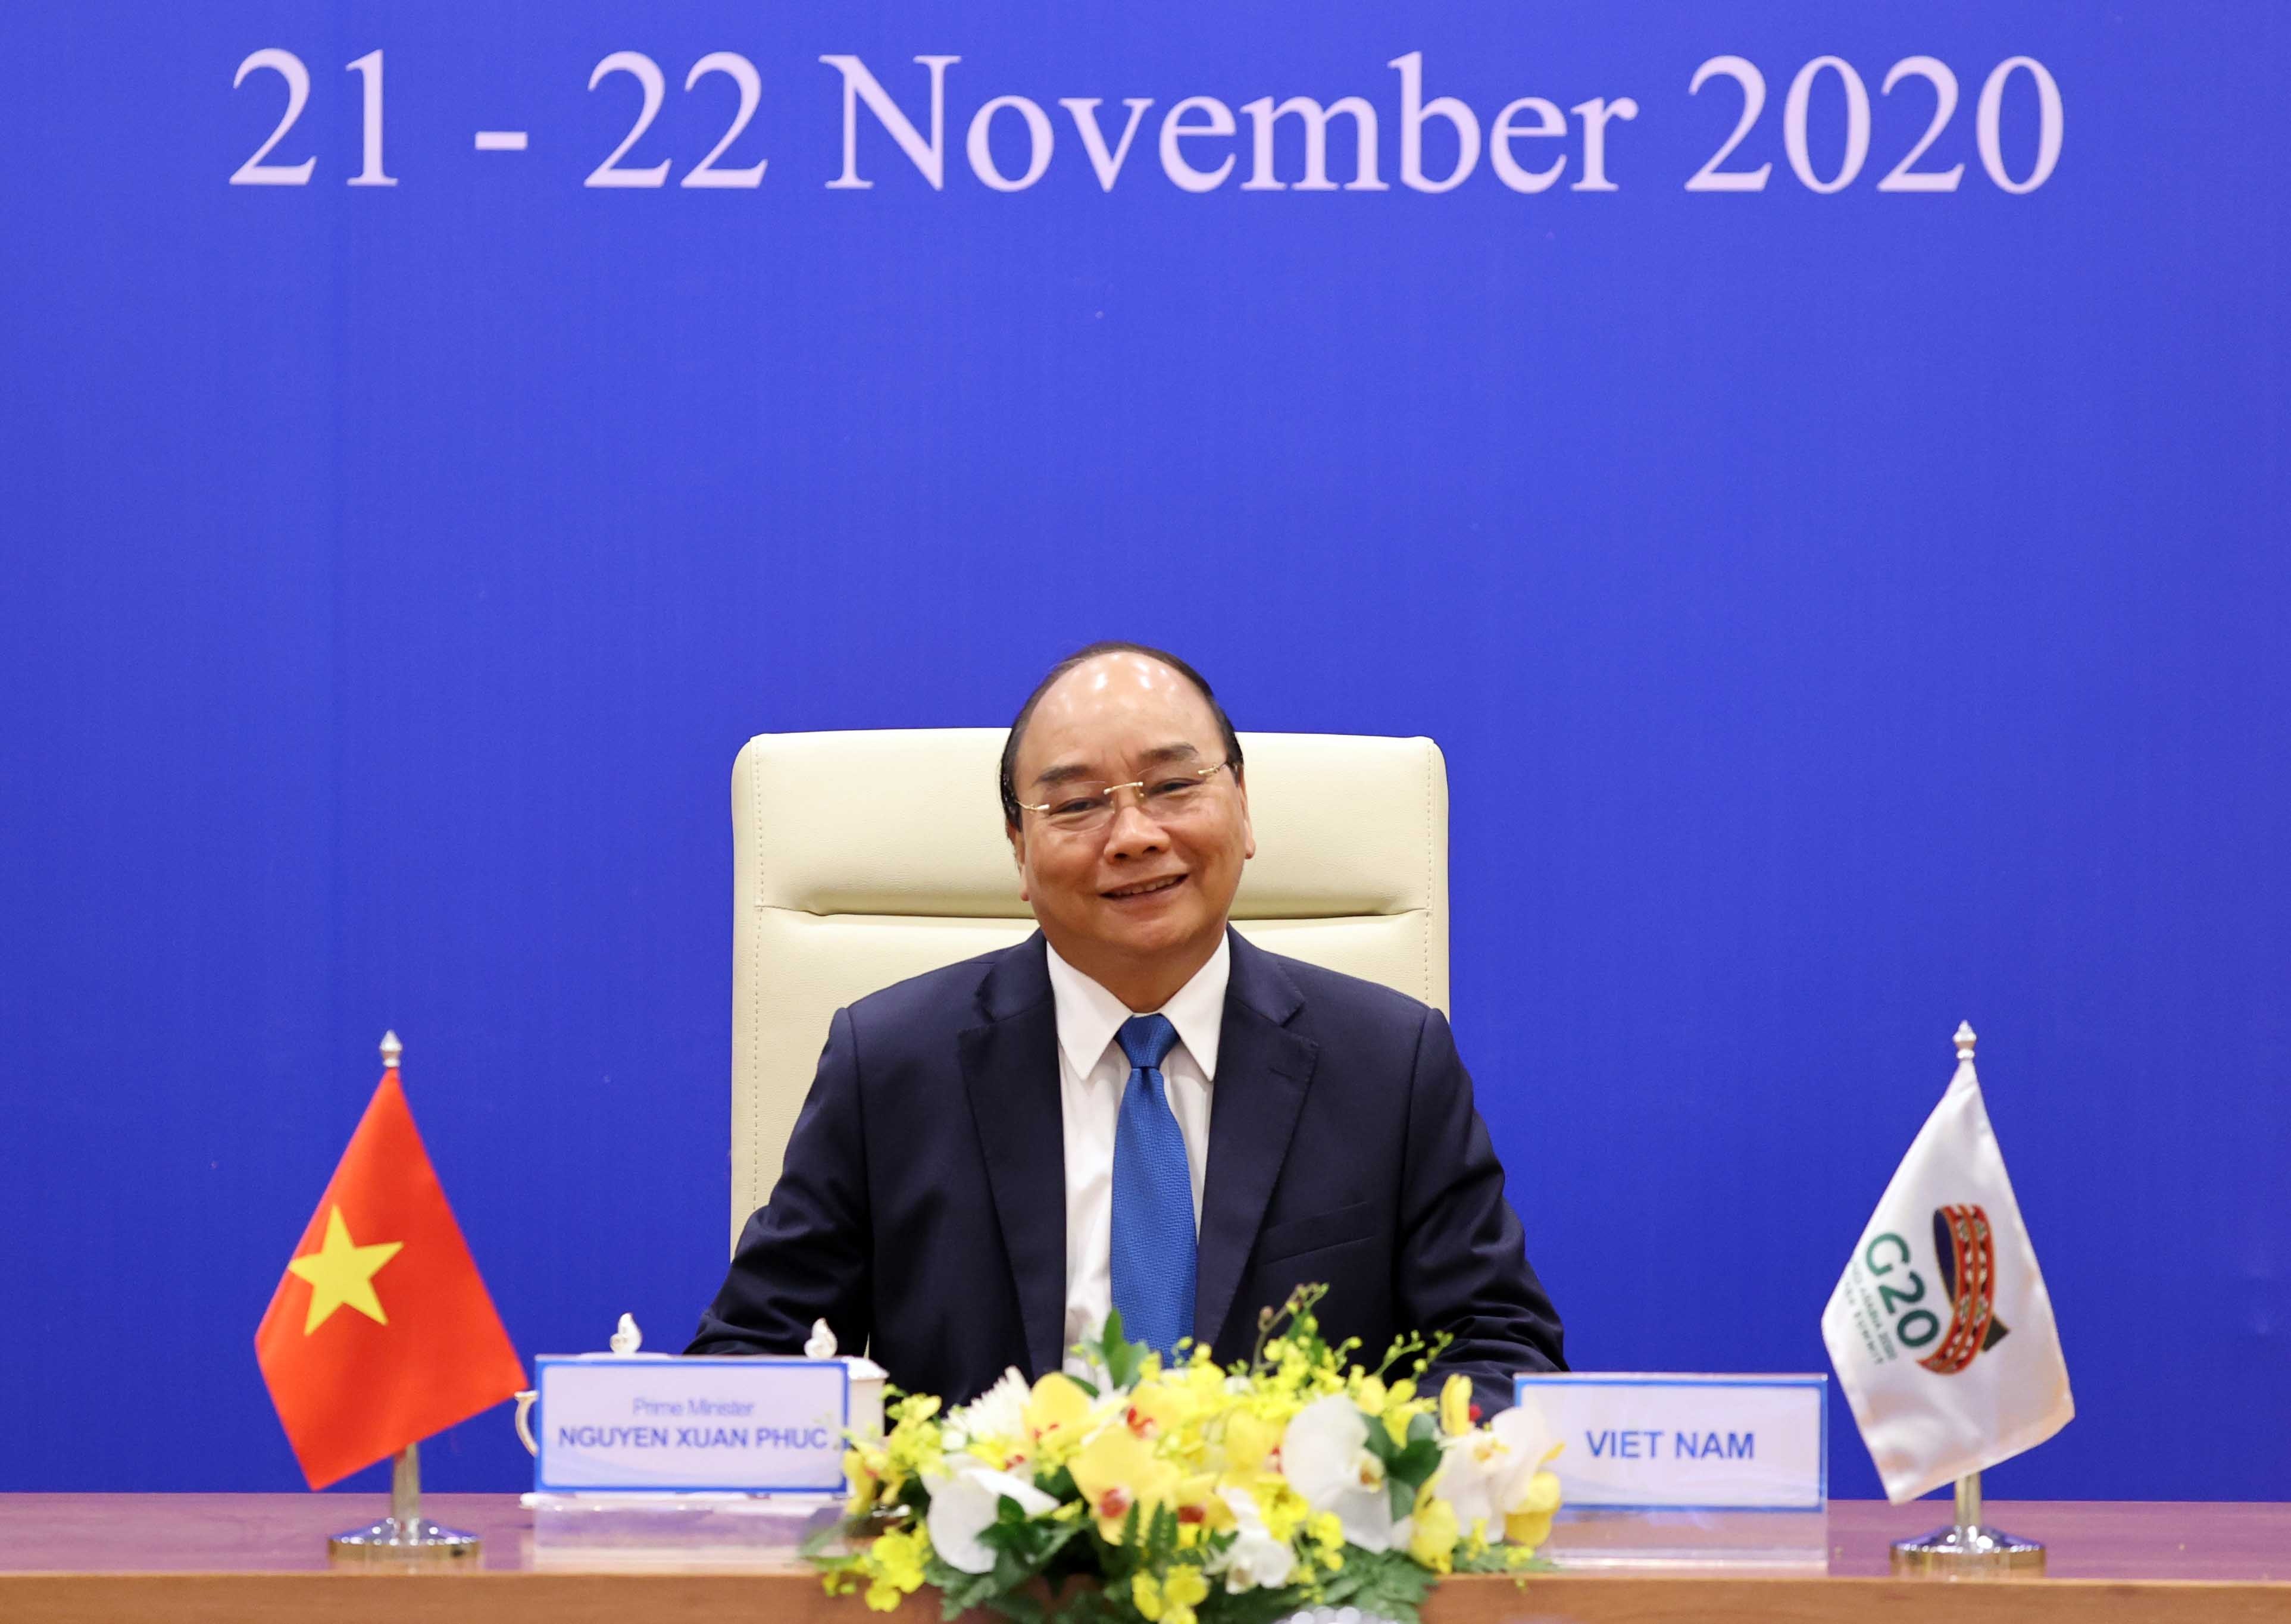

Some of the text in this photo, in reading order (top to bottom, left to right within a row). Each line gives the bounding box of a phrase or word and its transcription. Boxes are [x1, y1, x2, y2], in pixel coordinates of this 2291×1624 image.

[230, 48, 2064, 193] 21 - 22 November 2020
[1866, 1232, 1939, 1348] G20
[633, 1398, 754, 1416] Prime Minister
[558, 1427, 828, 1449] NGUYEN XUAN PHUC
[1586, 1429, 1754, 1459] VIET NAM
